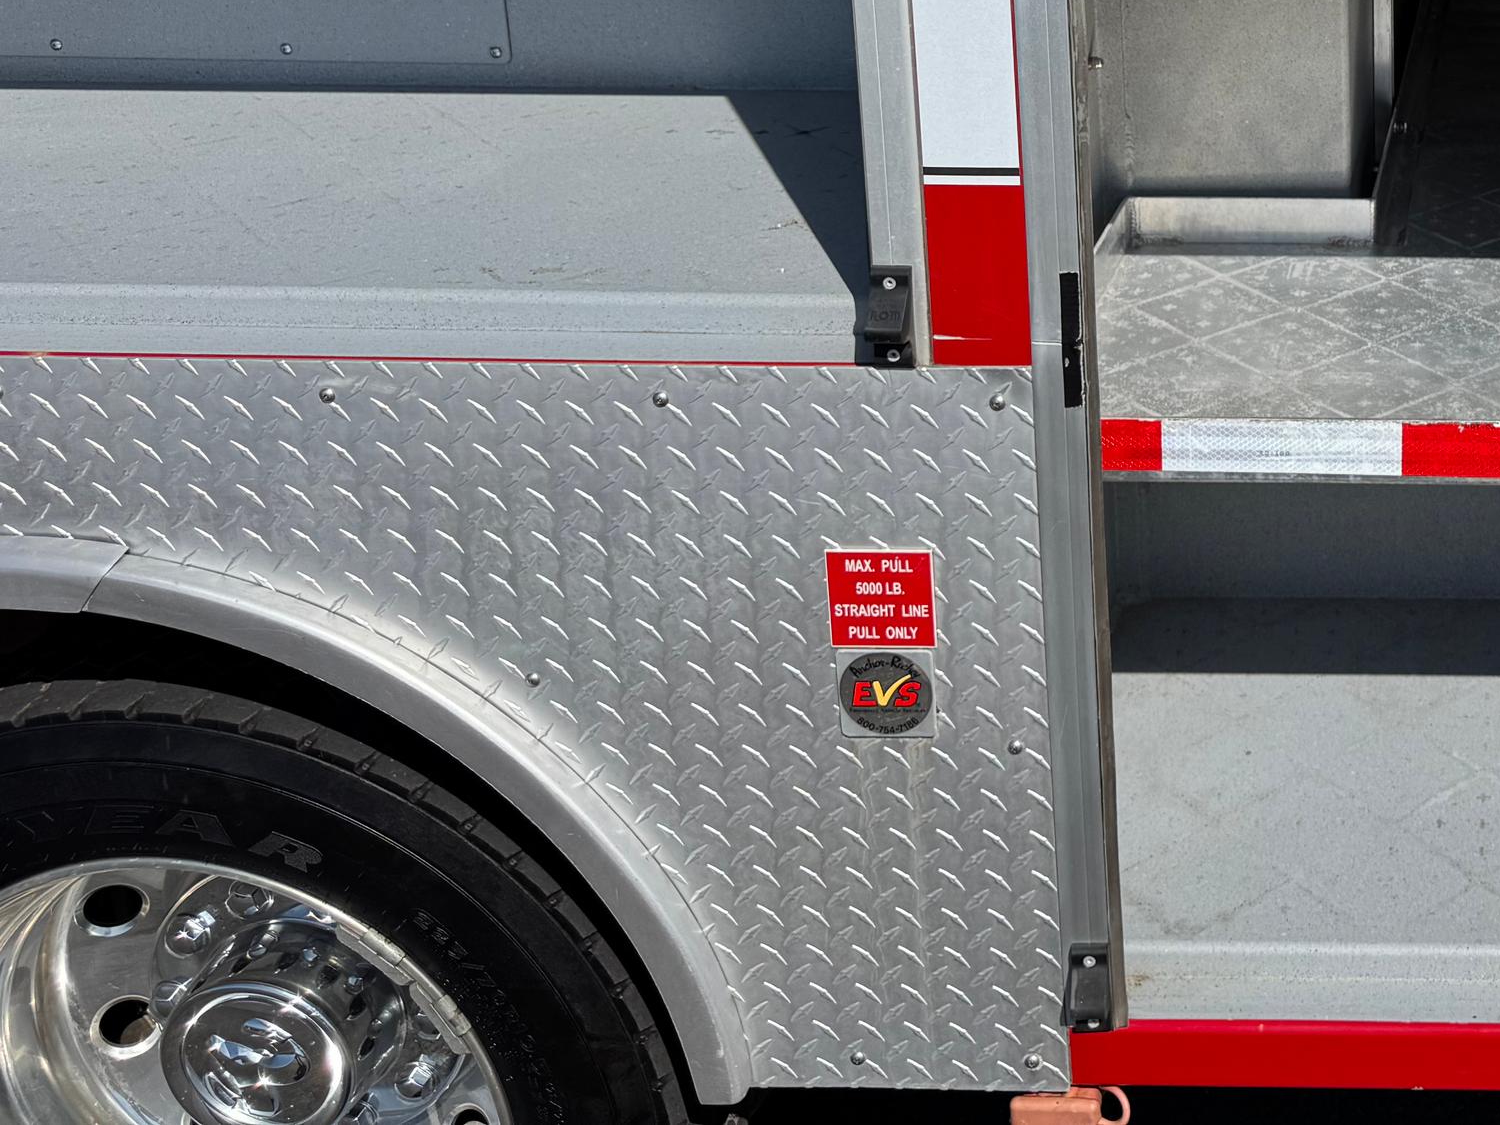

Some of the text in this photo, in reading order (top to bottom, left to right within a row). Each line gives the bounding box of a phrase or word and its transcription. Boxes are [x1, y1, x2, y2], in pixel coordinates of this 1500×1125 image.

[845, 559, 914, 573] MAX. PULL
[855, 582, 905, 596] 5000 LB.
[834, 604, 930, 618] STRAIGHT LINE
[848, 626, 919, 640] PULL ONLY
[851, 674, 922, 708] EVS
